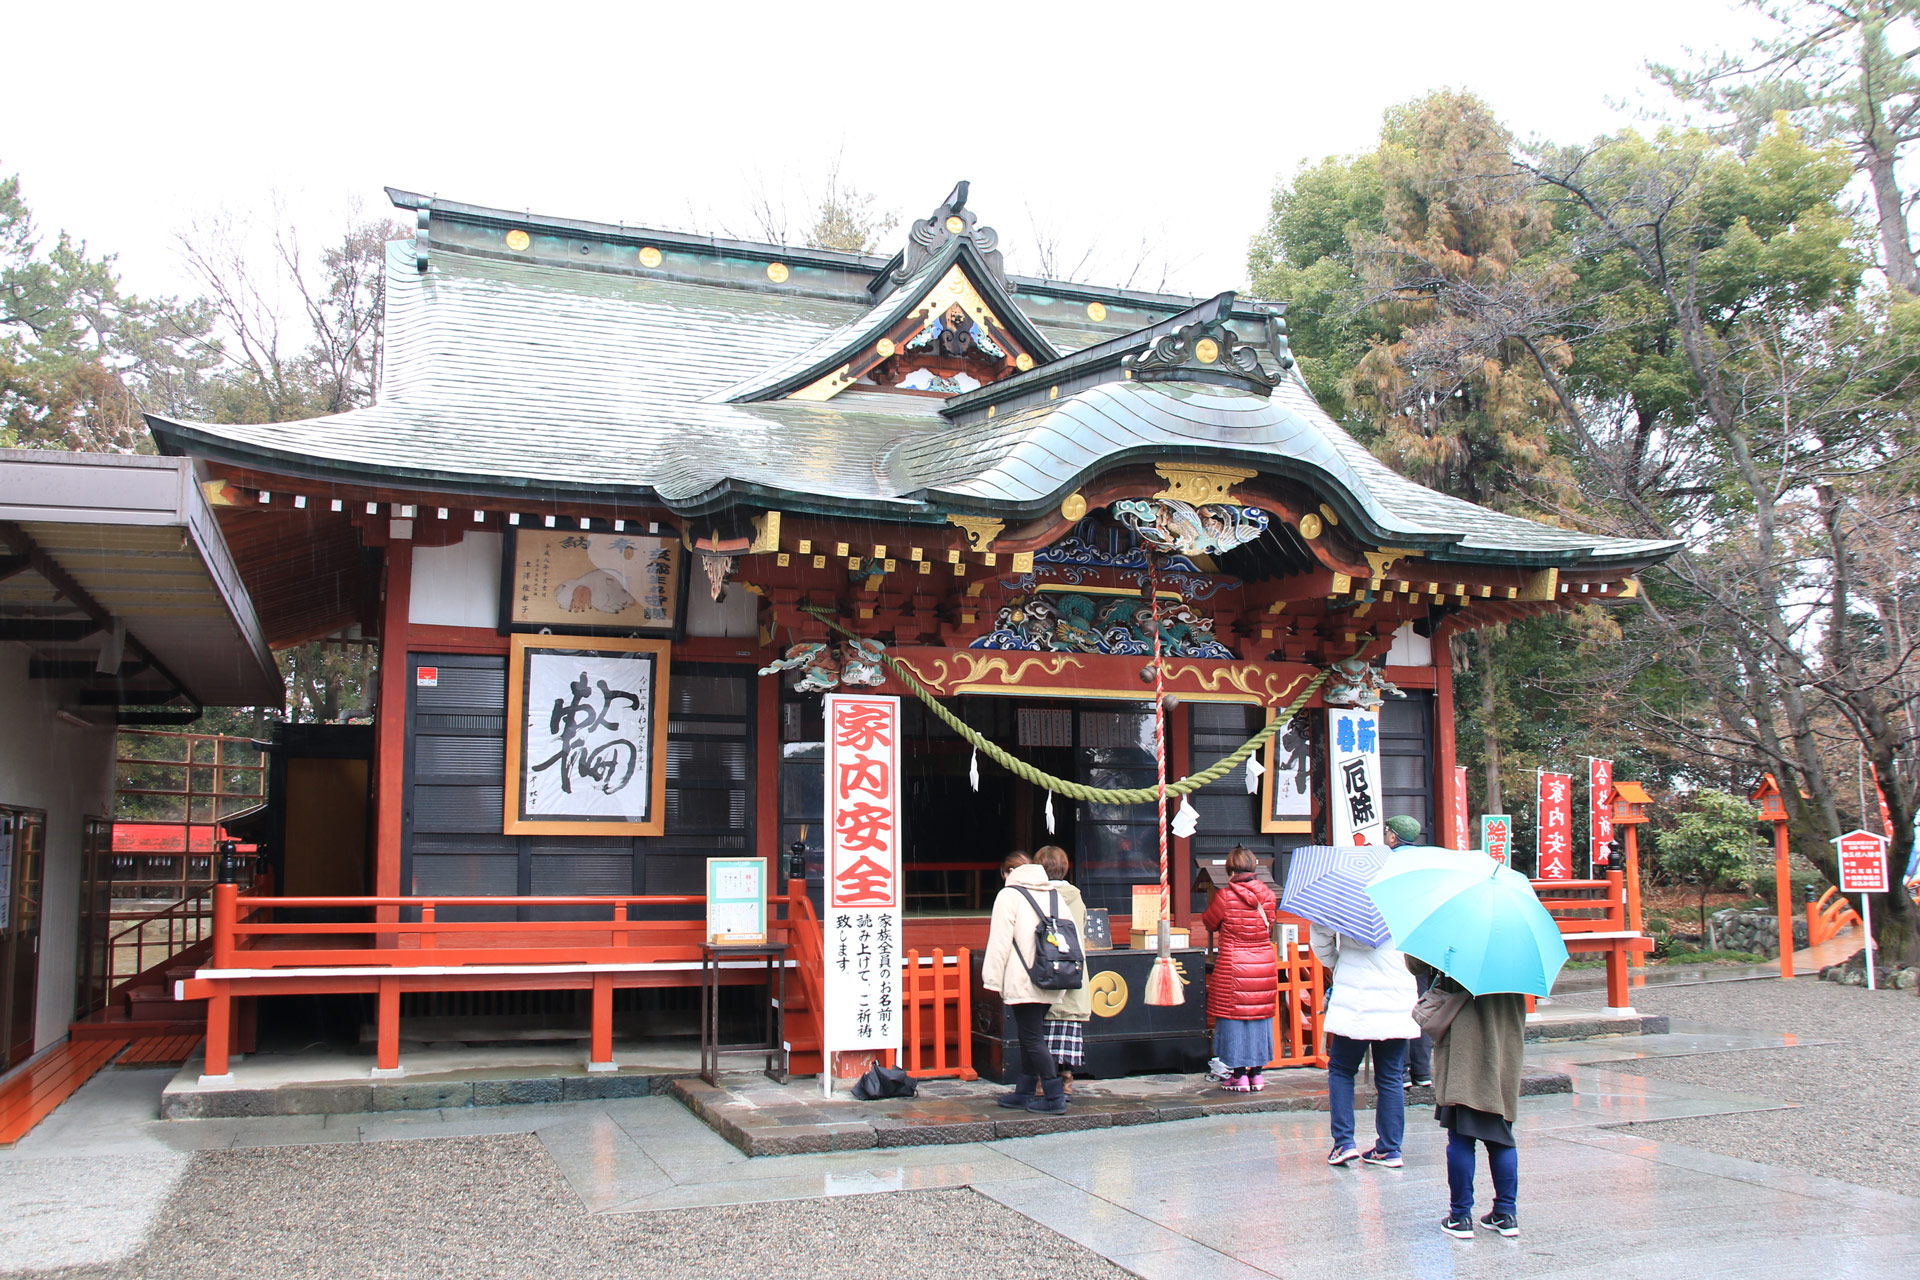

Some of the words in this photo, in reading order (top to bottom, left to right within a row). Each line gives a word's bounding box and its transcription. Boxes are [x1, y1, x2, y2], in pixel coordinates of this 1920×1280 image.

[559, 536, 639, 553] 奉納
[1337, 716, 1376, 754] 新春
[836, 704, 892, 903] 家内安全
[1342, 759, 1375, 827] 厄除
[1487, 820, 1507, 864] 絵馬
[836, 914, 852, 975] 致します。
[856, 913, 873, 1038] 読み上げて、ご祈祷
[877, 913, 893, 1036] 家族全員のお名前を
